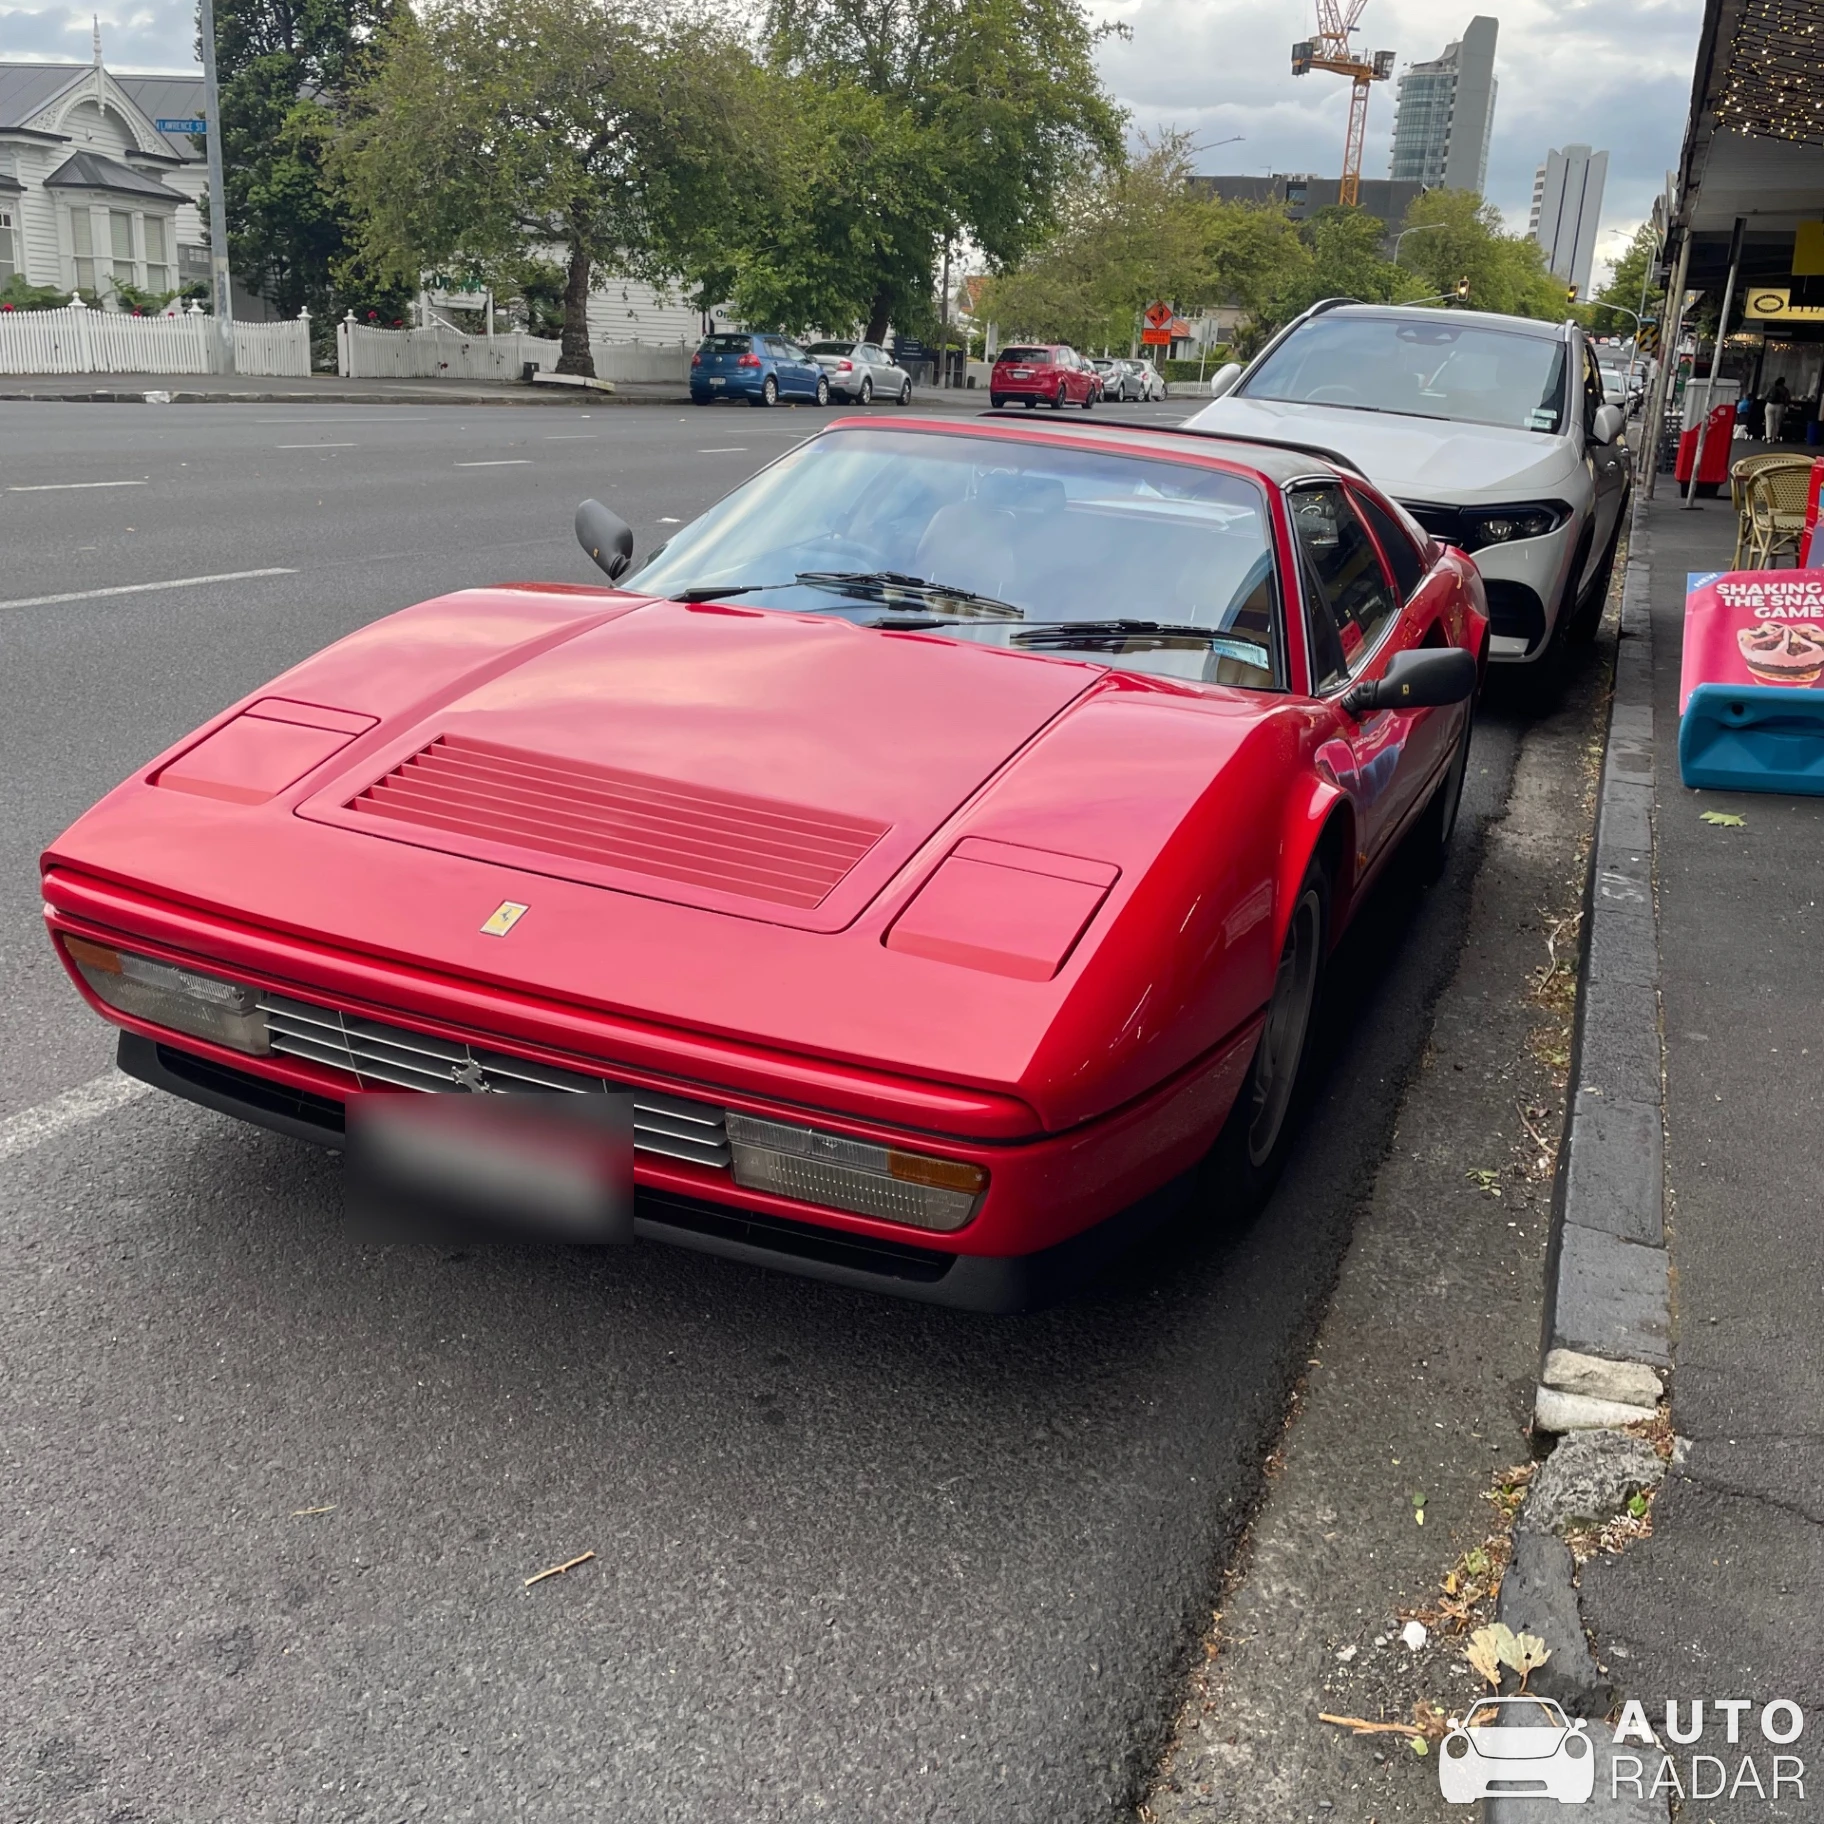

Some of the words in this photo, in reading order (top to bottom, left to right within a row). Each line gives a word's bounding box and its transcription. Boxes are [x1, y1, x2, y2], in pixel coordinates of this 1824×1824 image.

[160, 121, 192, 131] LAWRENCE
[196, 121, 204, 131] ST
[1693, 572, 1718, 588] NEW
[1716, 582, 1823, 595] SHAKING
[1721, 595, 1765, 607] THE
[1754, 606, 1824, 618] GAME
